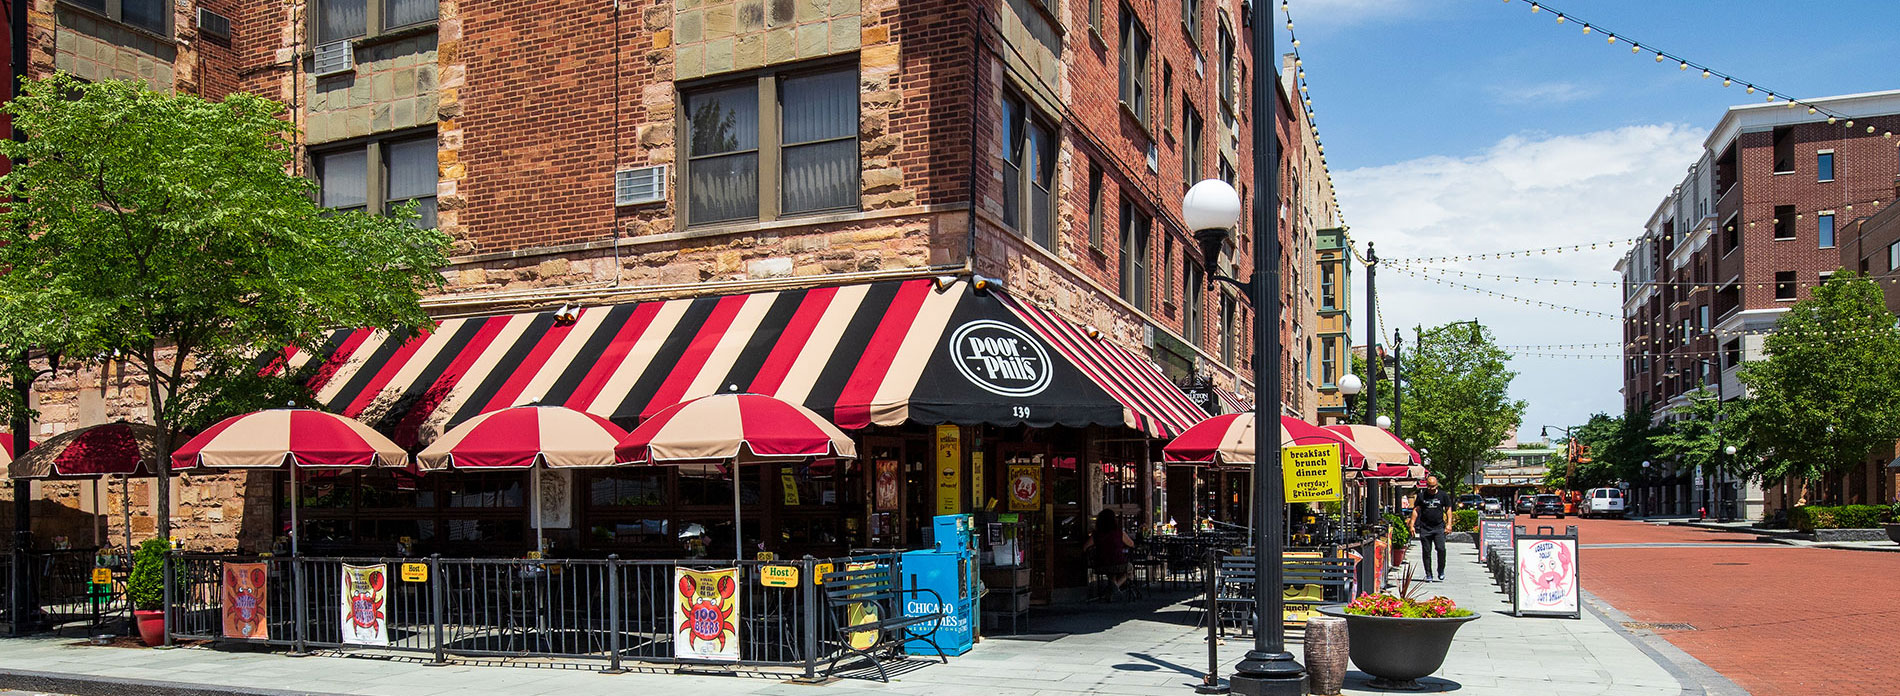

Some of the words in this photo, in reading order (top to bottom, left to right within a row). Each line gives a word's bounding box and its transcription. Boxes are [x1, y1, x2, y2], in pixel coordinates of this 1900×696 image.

[1013, 406, 1030, 418] 139
[1290, 450, 1331, 458] breakfast
[1295, 458, 1327, 467] brunch
[1297, 480, 1329, 488] everyday!
[1293, 488, 1333, 498] grillroom
[770, 567, 789, 576] Host
[695, 608, 717, 620] 100
[1283, 603, 1310, 616] runch!
[695, 621, 719, 635] BEERS
